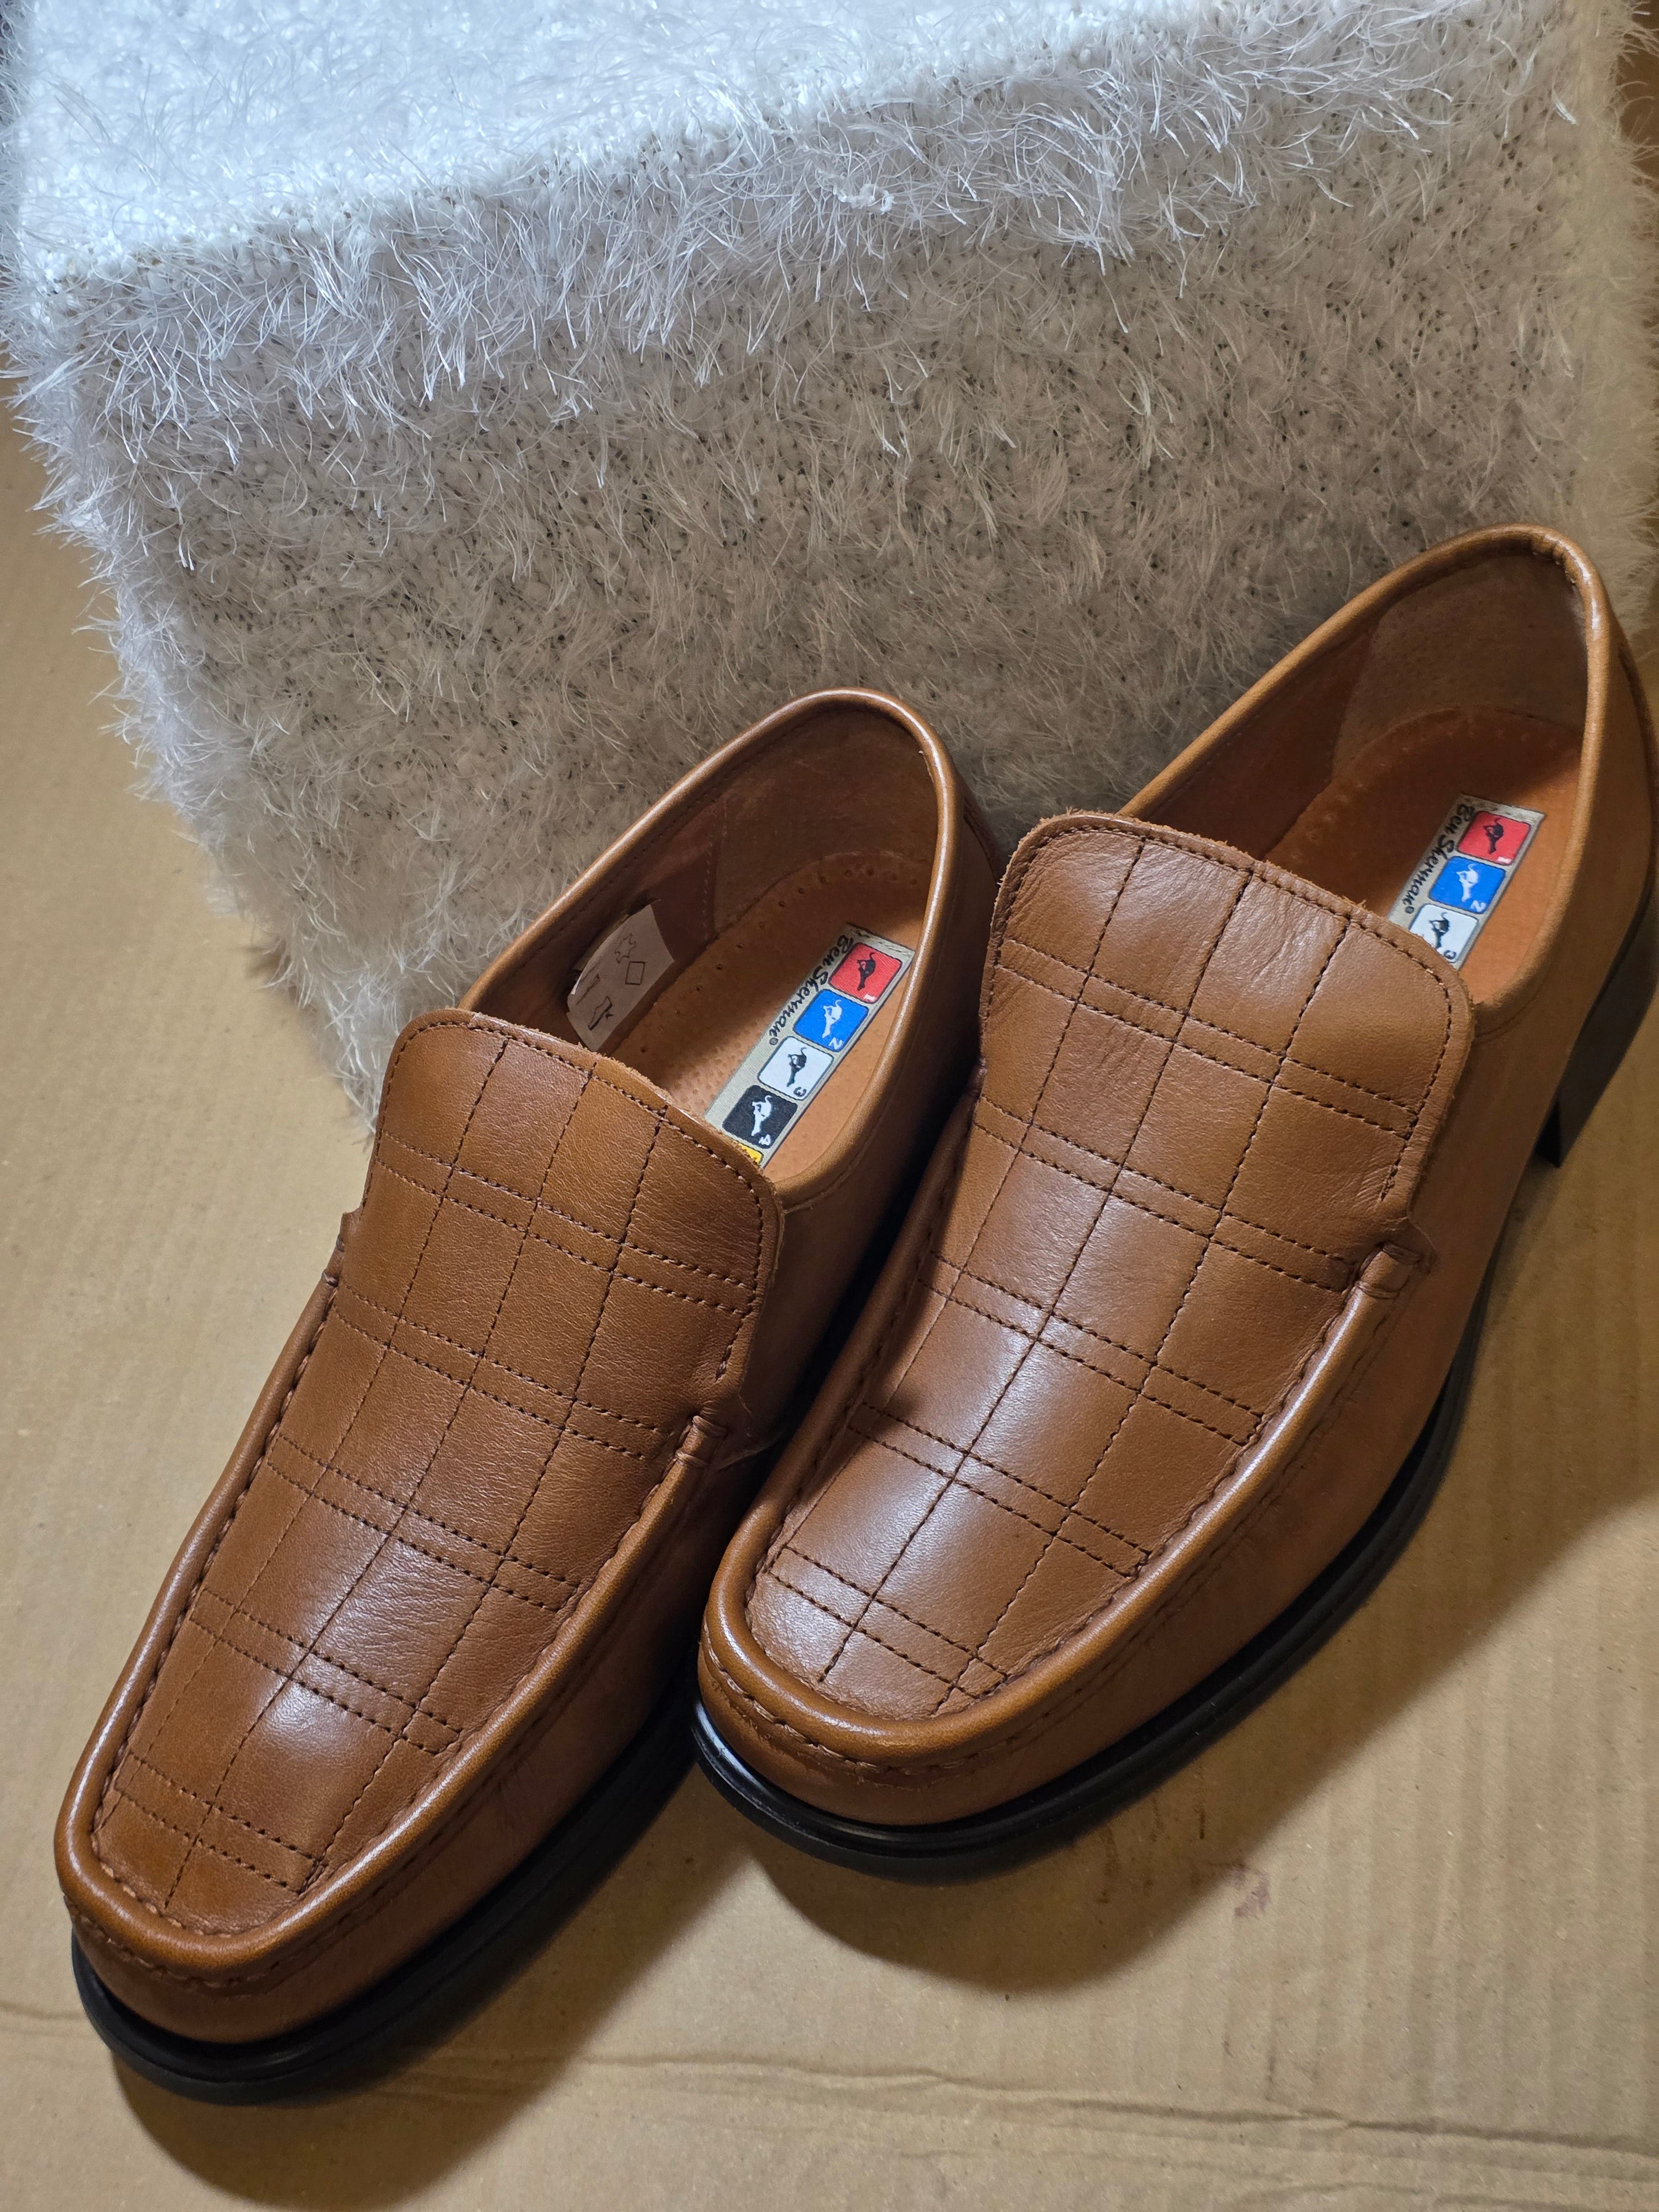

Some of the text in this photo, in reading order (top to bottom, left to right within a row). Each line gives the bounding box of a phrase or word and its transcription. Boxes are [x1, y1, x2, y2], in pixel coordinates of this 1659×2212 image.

[1445, 804, 1475, 834] Ben
[1470, 900, 1486, 912] 2
[822, 934, 853, 966] Ben
[828, 1037, 843, 1049] 2
[793, 1087, 807, 1097] 3
[758, 1134, 771, 1146] 4
